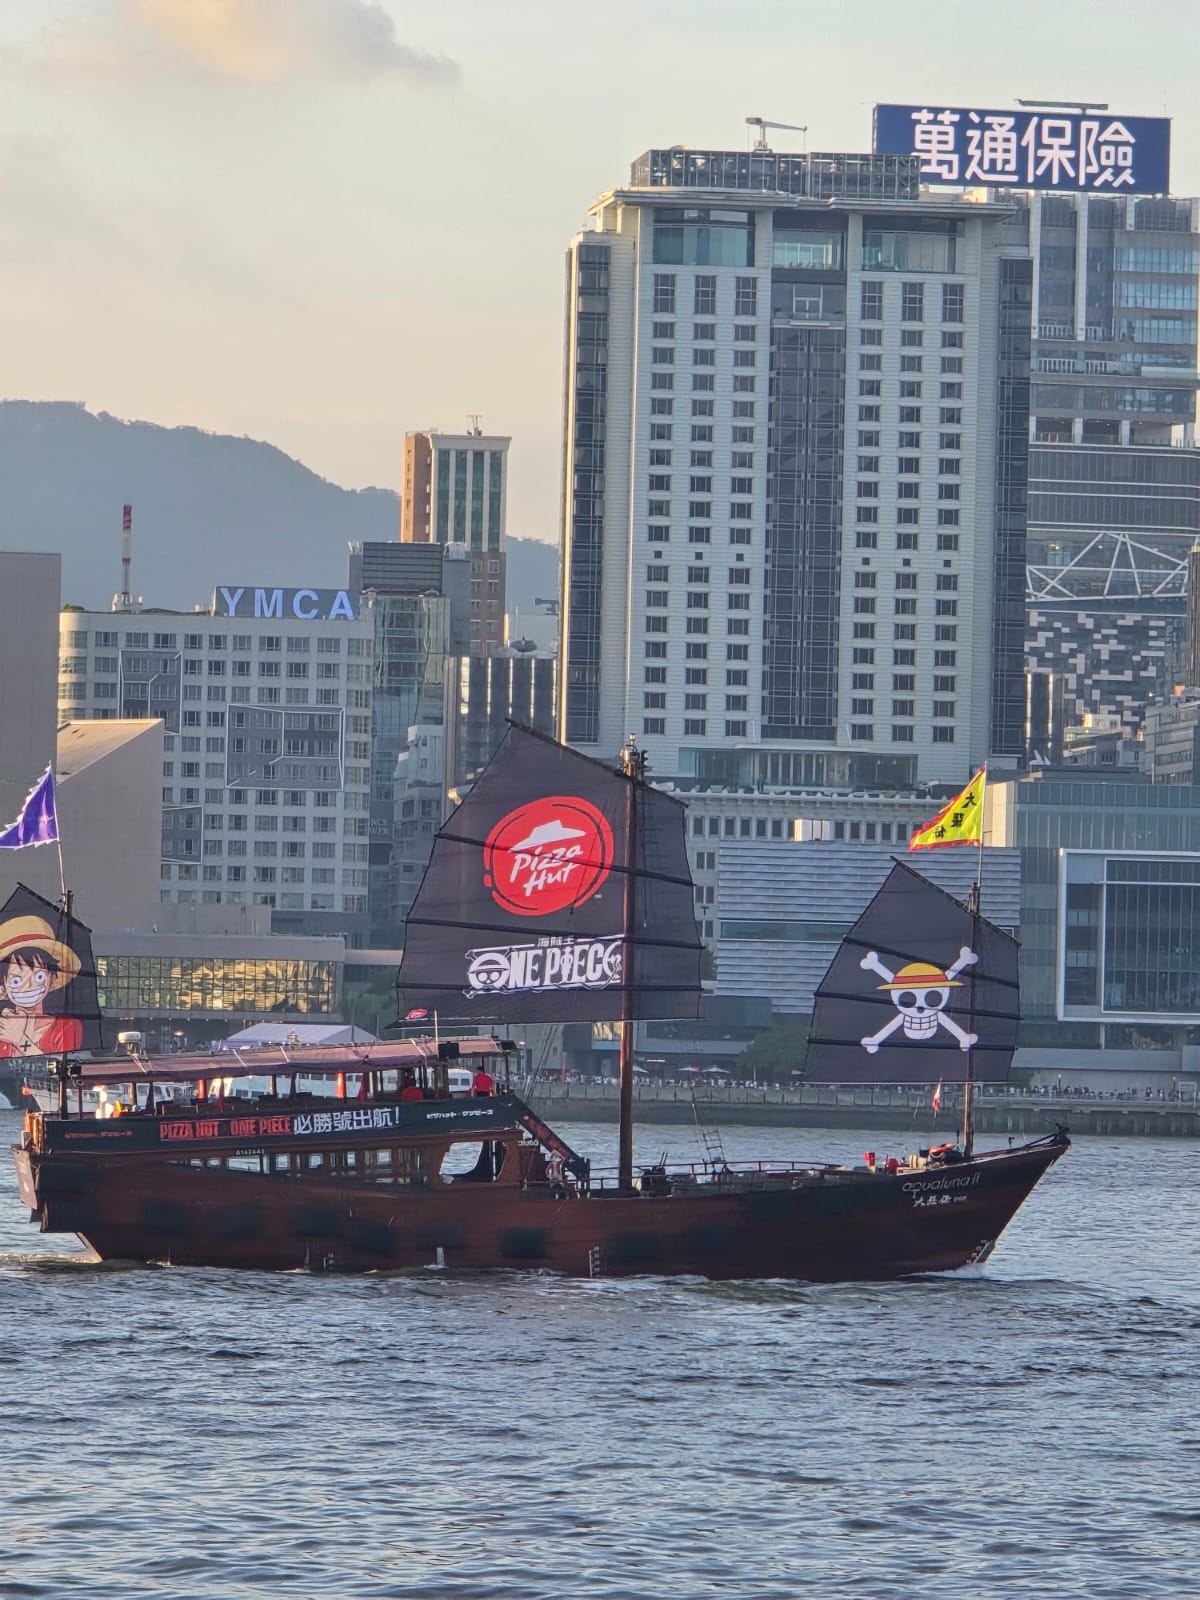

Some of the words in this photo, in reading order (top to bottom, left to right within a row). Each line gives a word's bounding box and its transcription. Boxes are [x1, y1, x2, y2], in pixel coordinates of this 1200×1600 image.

[911, 108, 1137, 188] 萬通保險
[219, 587, 355, 620] YMCA
[510, 845, 583, 883] Pizza
[523, 862, 579, 896] Hut
[160, 1122, 193, 1140] PIZZA
[196, 1120, 220, 1138] HUT
[230, 1119, 257, 1137] ONE
[259, 1116, 291, 1135] PIECE
